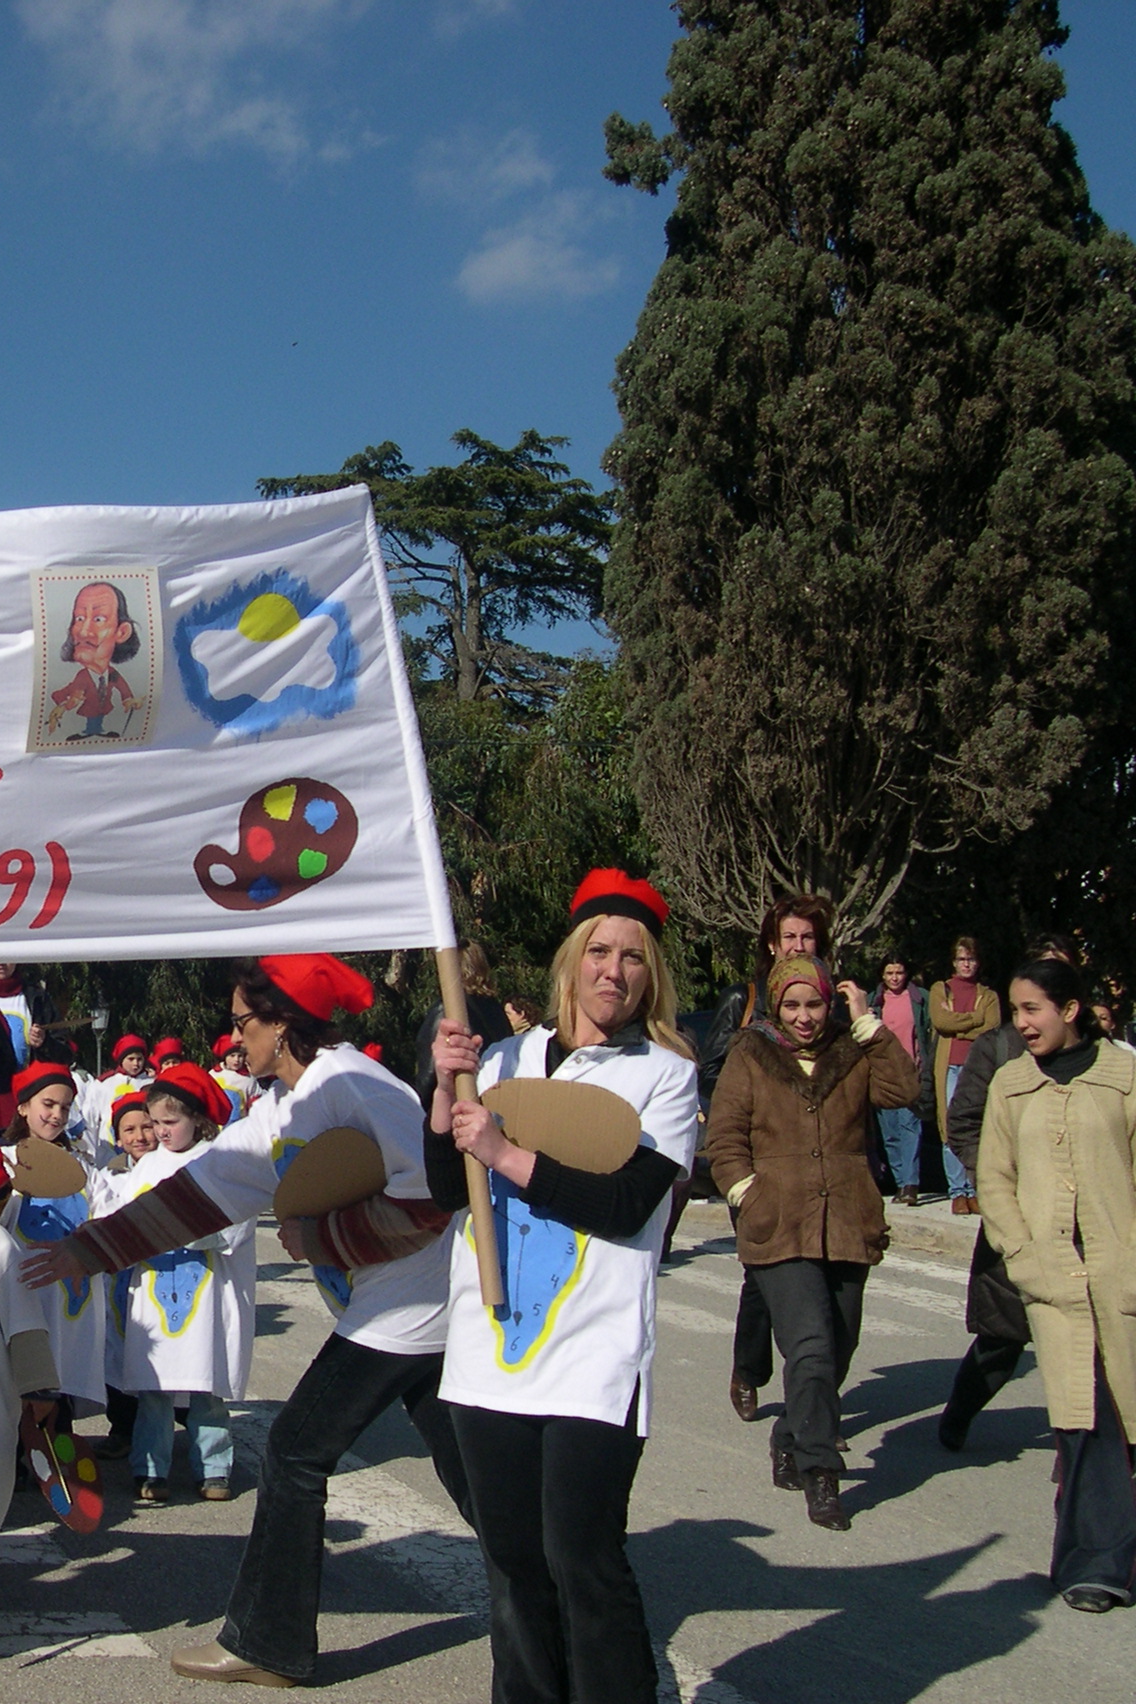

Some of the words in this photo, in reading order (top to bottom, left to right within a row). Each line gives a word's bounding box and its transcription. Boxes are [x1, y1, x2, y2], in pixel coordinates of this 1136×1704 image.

[566, 1242, 576, 1256] 3
[551, 1274, 559, 1290] 4
[171, 1310, 179, 1322] 6
[532, 1303, 542, 1317] 5
[510, 1336, 521, 1352] 6
